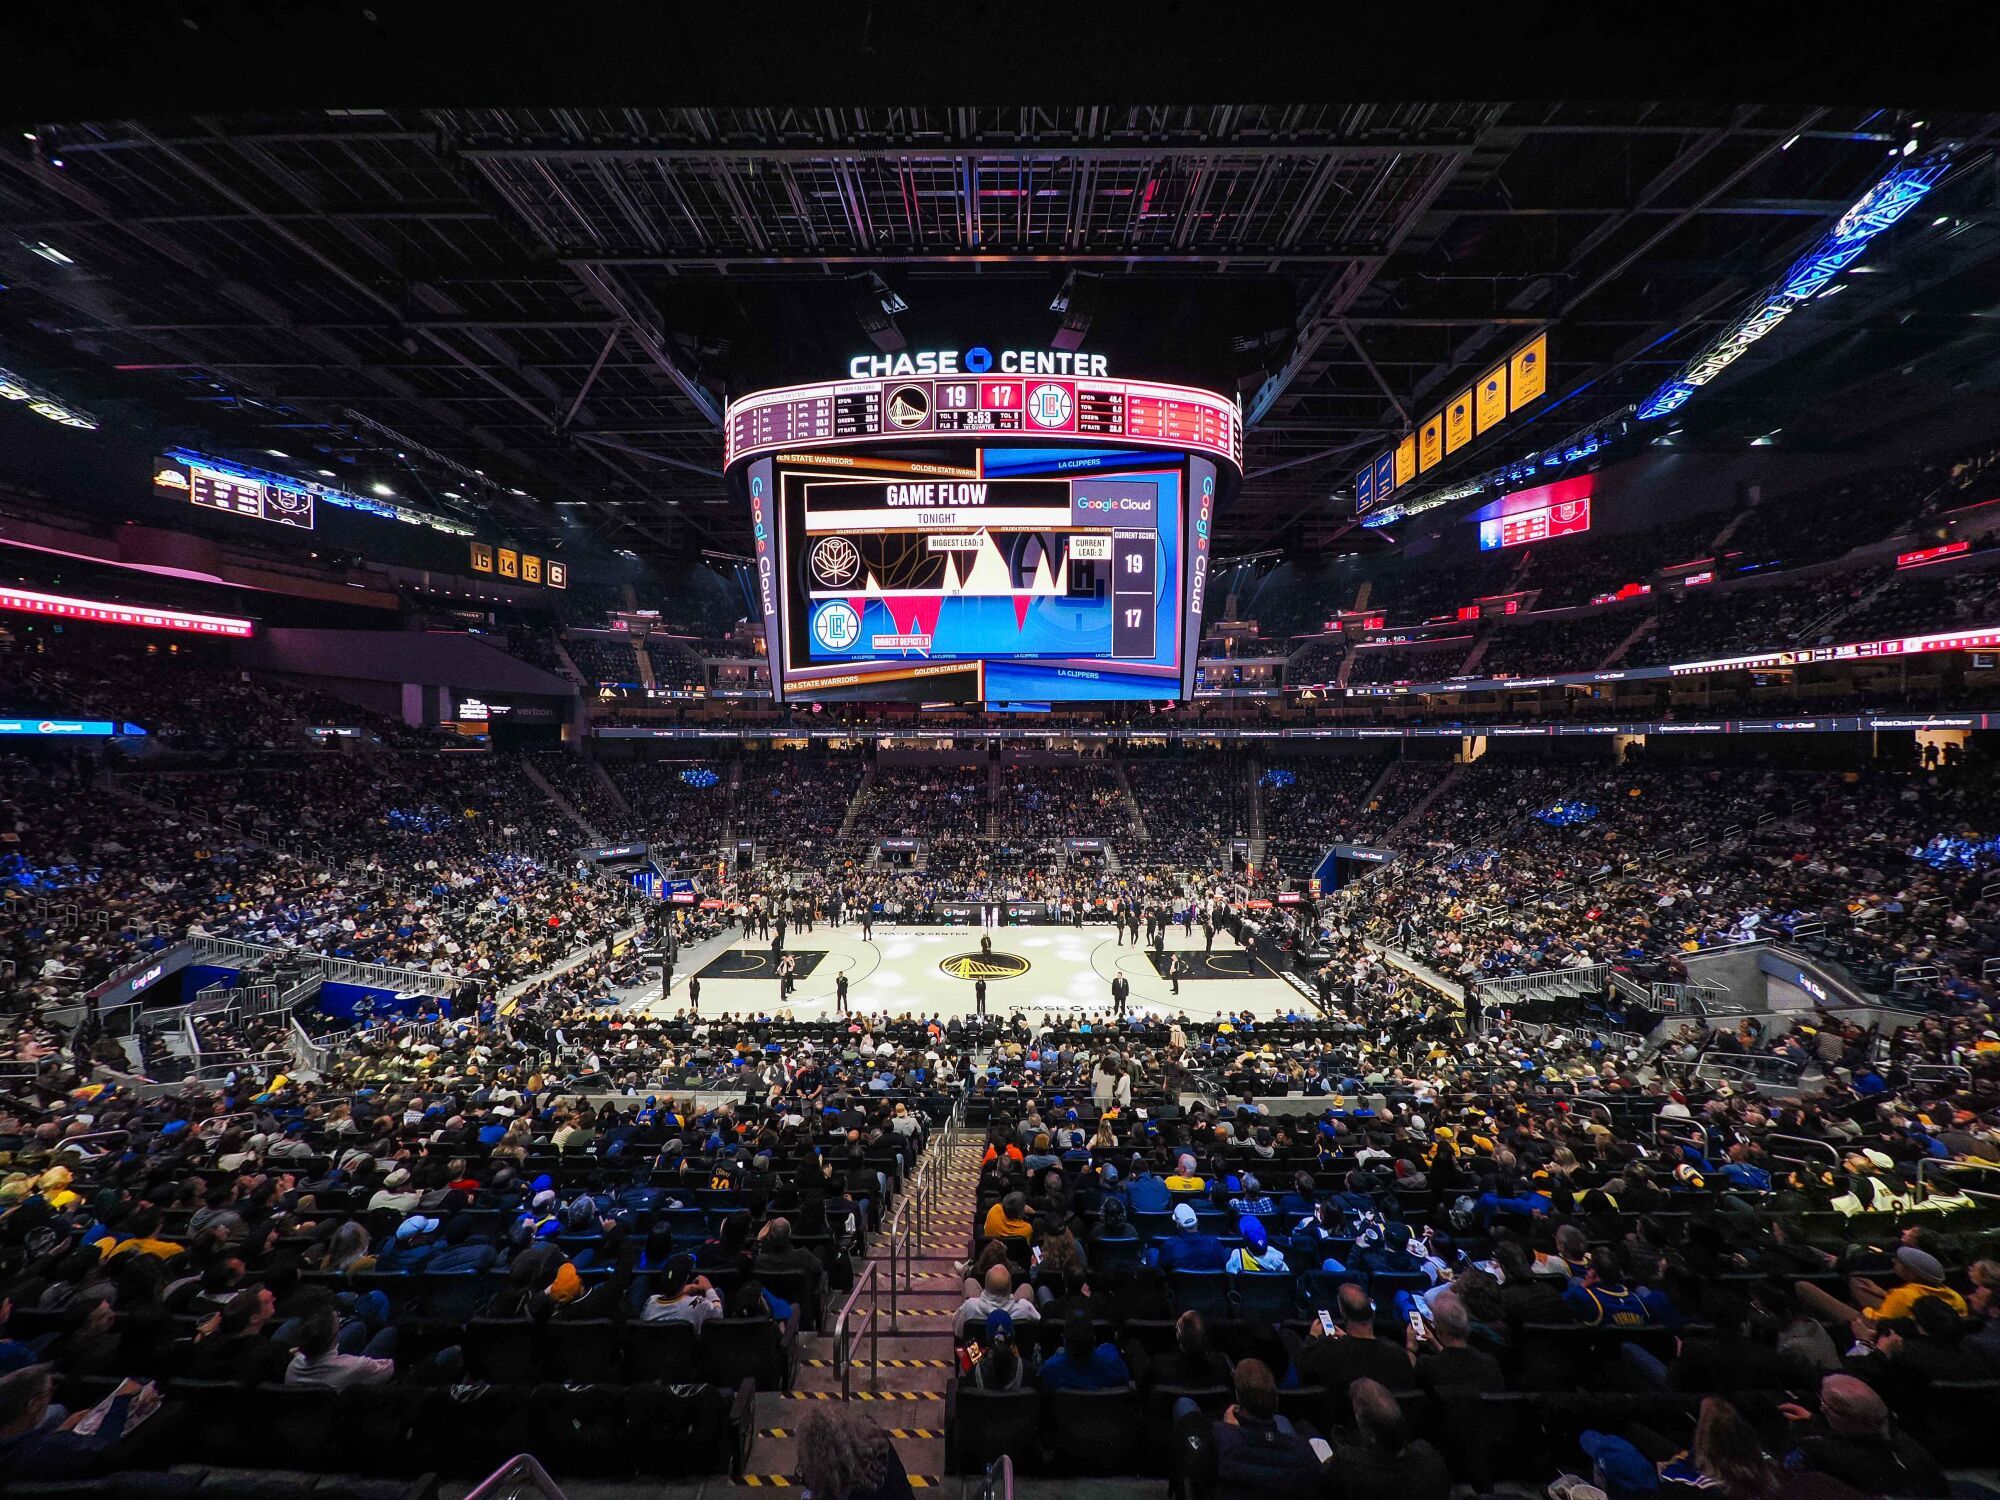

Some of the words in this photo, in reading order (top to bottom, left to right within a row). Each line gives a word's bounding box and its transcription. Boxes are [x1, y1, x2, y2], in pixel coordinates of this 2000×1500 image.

[850, 351, 958, 378] CHASE
[1001, 351, 1108, 377] CENTER
[946, 386, 966, 407] 19
[992, 386, 1011, 407] 17
[967, 412, 990, 423] 3:53
[815, 457, 853, 466] WARRIORS
[911, 464, 937, 472] GOLDEN
[1069, 459, 1100, 468] CLIPPERS
[886, 485, 935, 506] GAME
[938, 484, 987, 505] FLOW
[1078, 497, 1118, 512] Google
[1120, 498, 1151, 510] Cloud
[918, 513, 956, 524] TONIGHT
[1196, 476, 1212, 550] Google
[752, 477, 766, 552] Google
[759, 556, 774, 615] Cloud
[474, 553, 488, 568] 16
[501, 559, 514, 573] 14
[1126, 554, 1143, 573] 19
[526, 565, 537, 579] 13
[552, 567, 562, 583] 6
[1192, 554, 1208, 613] Cloud
[1125, 609, 1142, 627] 17
[874, 638, 899, 646] BIGGEST
[900, 638, 924, 646] DEFICIT:
[1067, 670, 1099, 679] CLIPPERS
[798, 680, 820, 689] STATE
[821, 676, 859, 685] WARRIORS
[711, 1177, 730, 1189] 30
